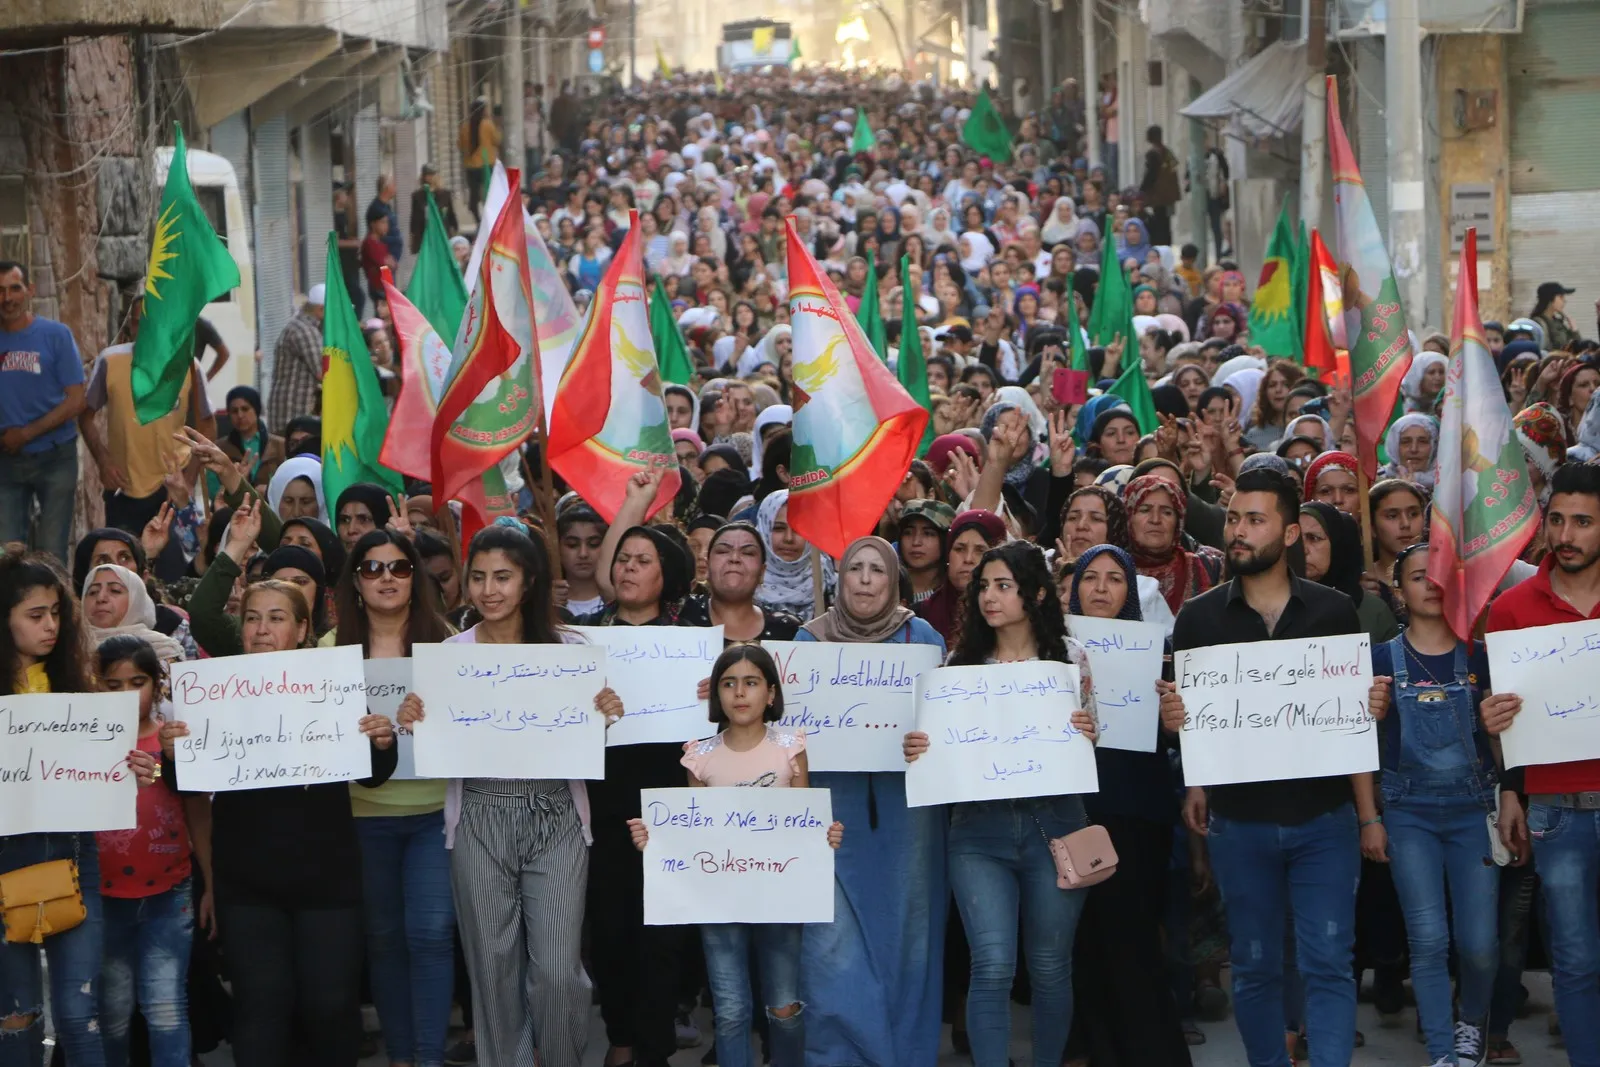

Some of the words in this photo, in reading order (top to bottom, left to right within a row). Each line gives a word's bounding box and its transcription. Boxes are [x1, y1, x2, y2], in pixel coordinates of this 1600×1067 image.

[174, 671, 315, 705] Berxwedan
[792, 668, 820, 696] ji
[1247, 664, 1284, 683] ser
[8, 703, 99, 735] berxwedanê
[88, 722, 125, 741] ya
[178, 718, 210, 763] gel
[277, 714, 292, 742] bi
[0, 747, 32, 783] urd
[648, 797, 714, 829] Destên
[751, 813, 778, 832] ji
[784, 808, 824, 828] erdên
[661, 857, 691, 872] me
